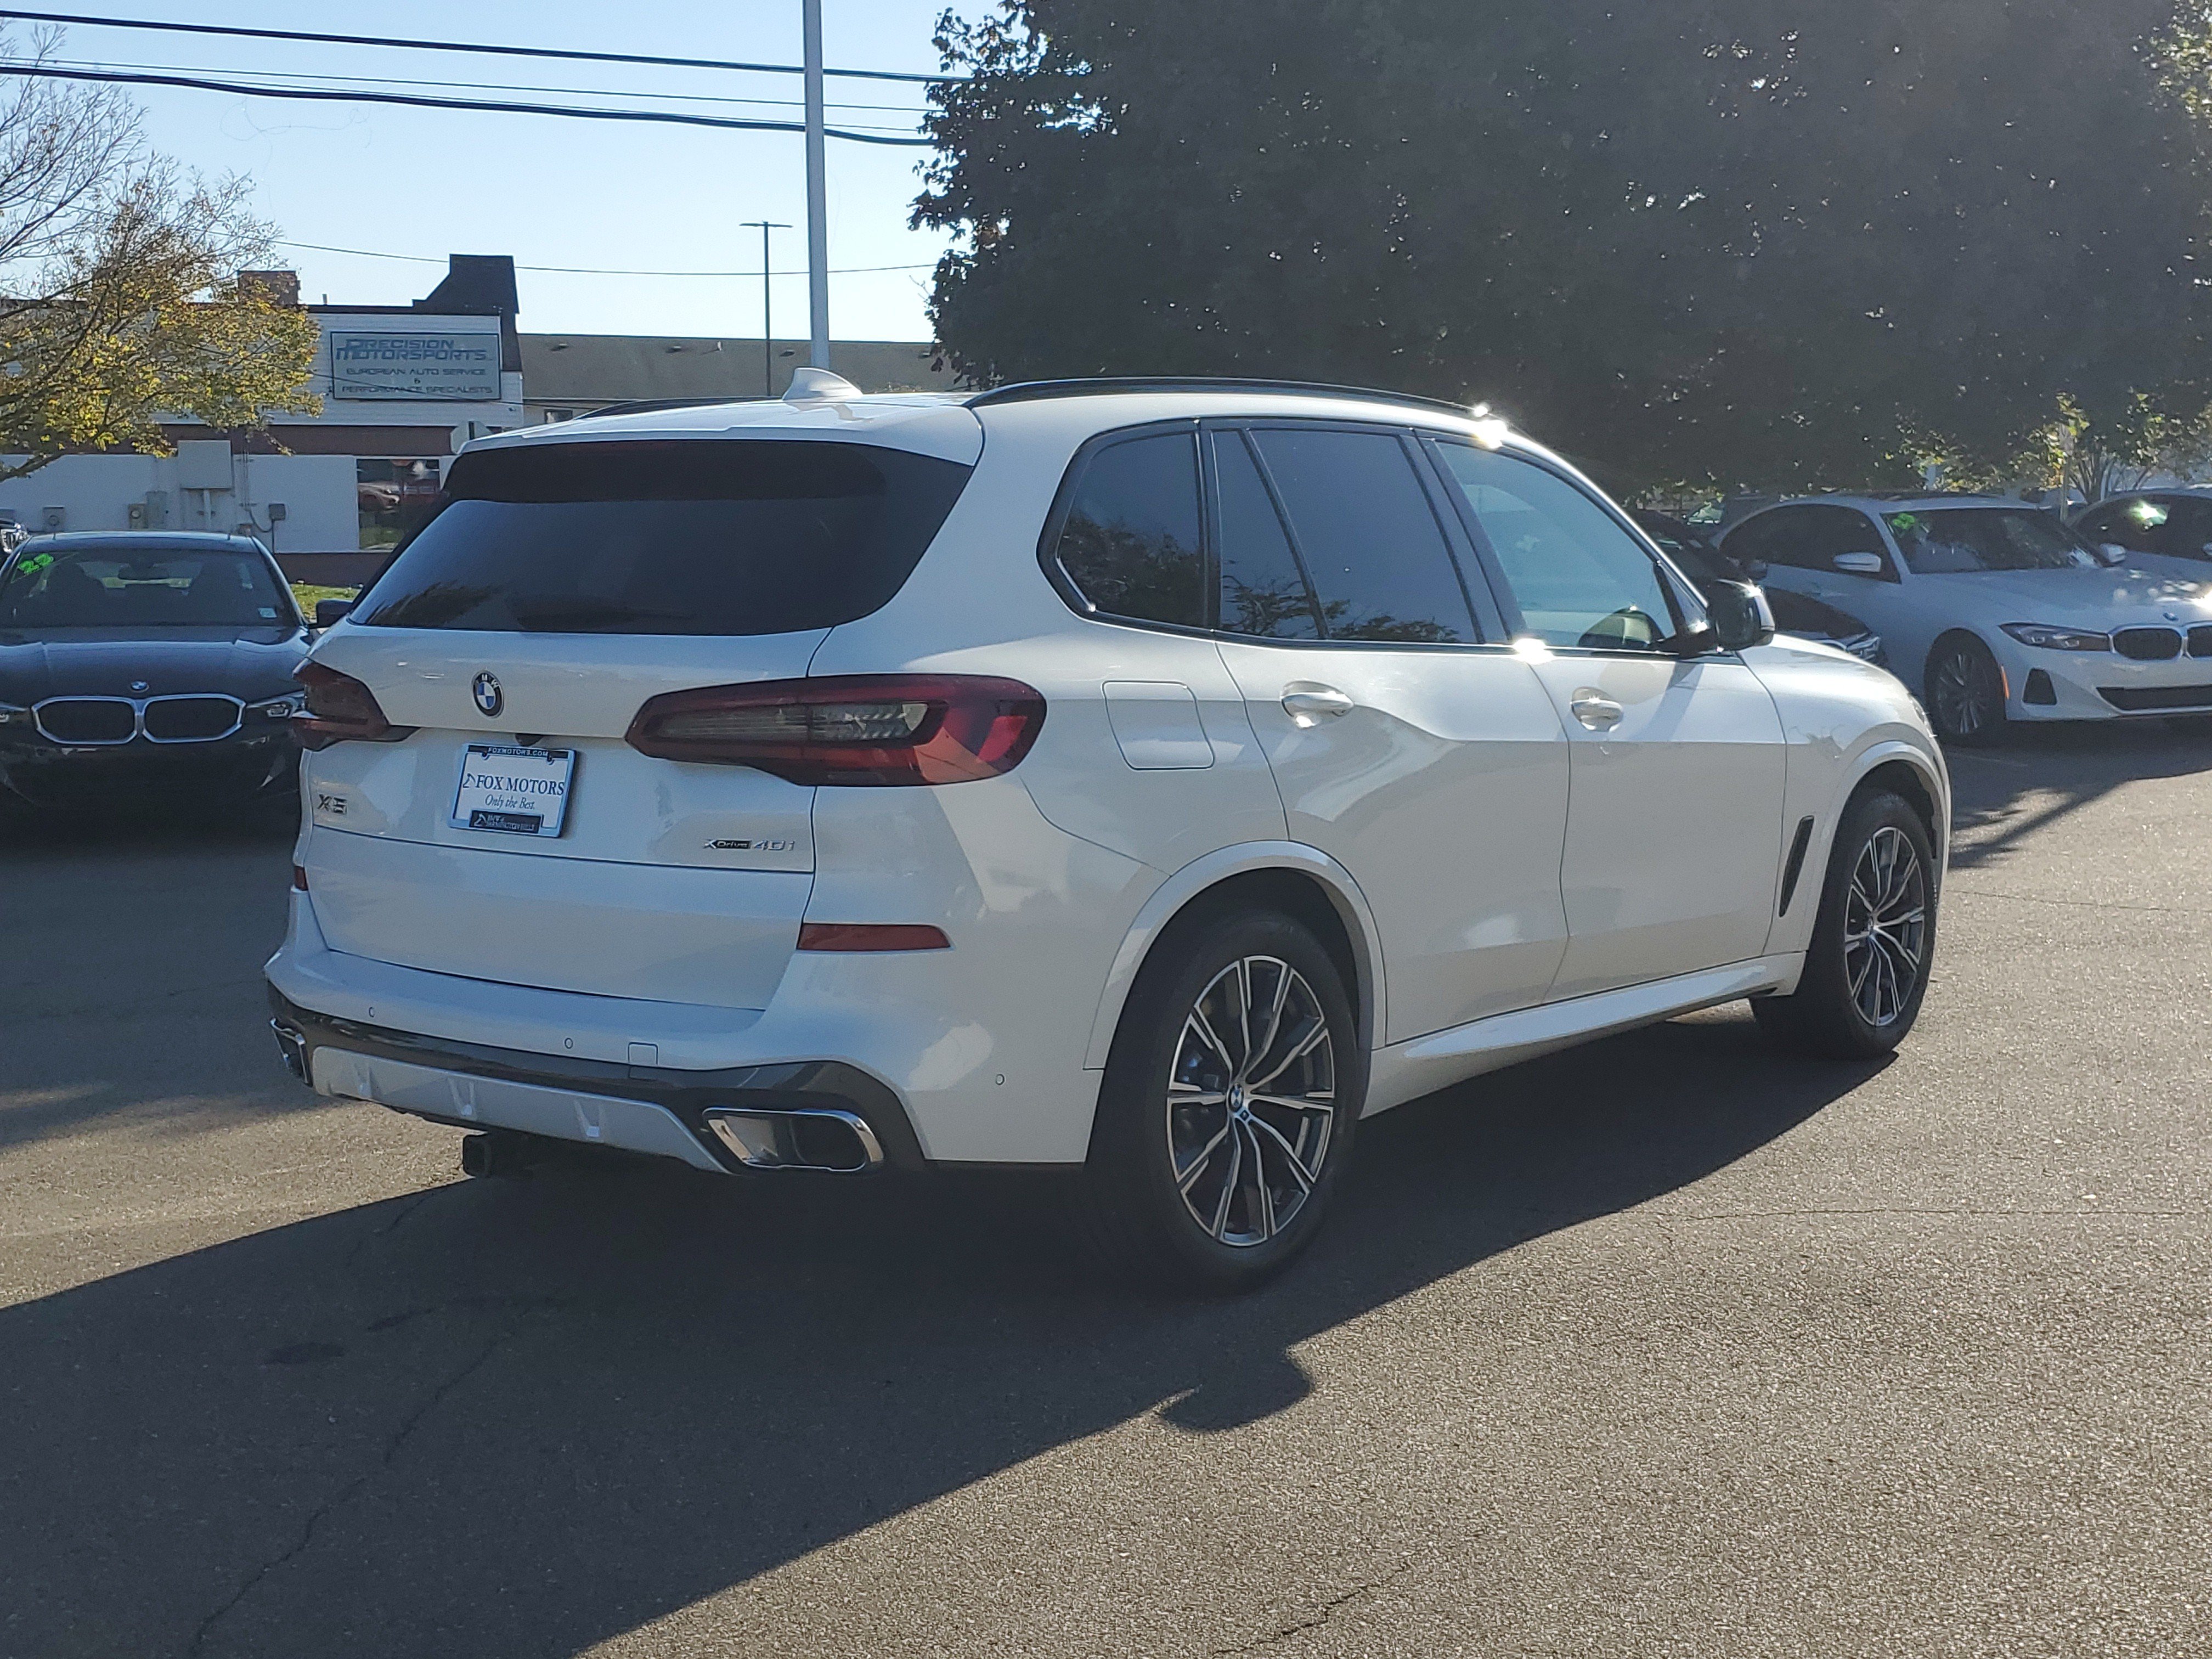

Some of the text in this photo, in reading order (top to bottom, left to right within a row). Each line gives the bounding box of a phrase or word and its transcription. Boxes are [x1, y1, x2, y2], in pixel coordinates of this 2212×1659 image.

[345, 339, 454, 349] PRECISION
[336, 348, 487, 360] MOTORSPORTS
[488, 747, 549, 757] FOXMOTORS.COM
[476, 775, 565, 796] FOX MOTORS
[318, 794, 348, 815] X5
[485, 794, 535, 810] Only the Best.
[754, 840, 795, 851] 40i
